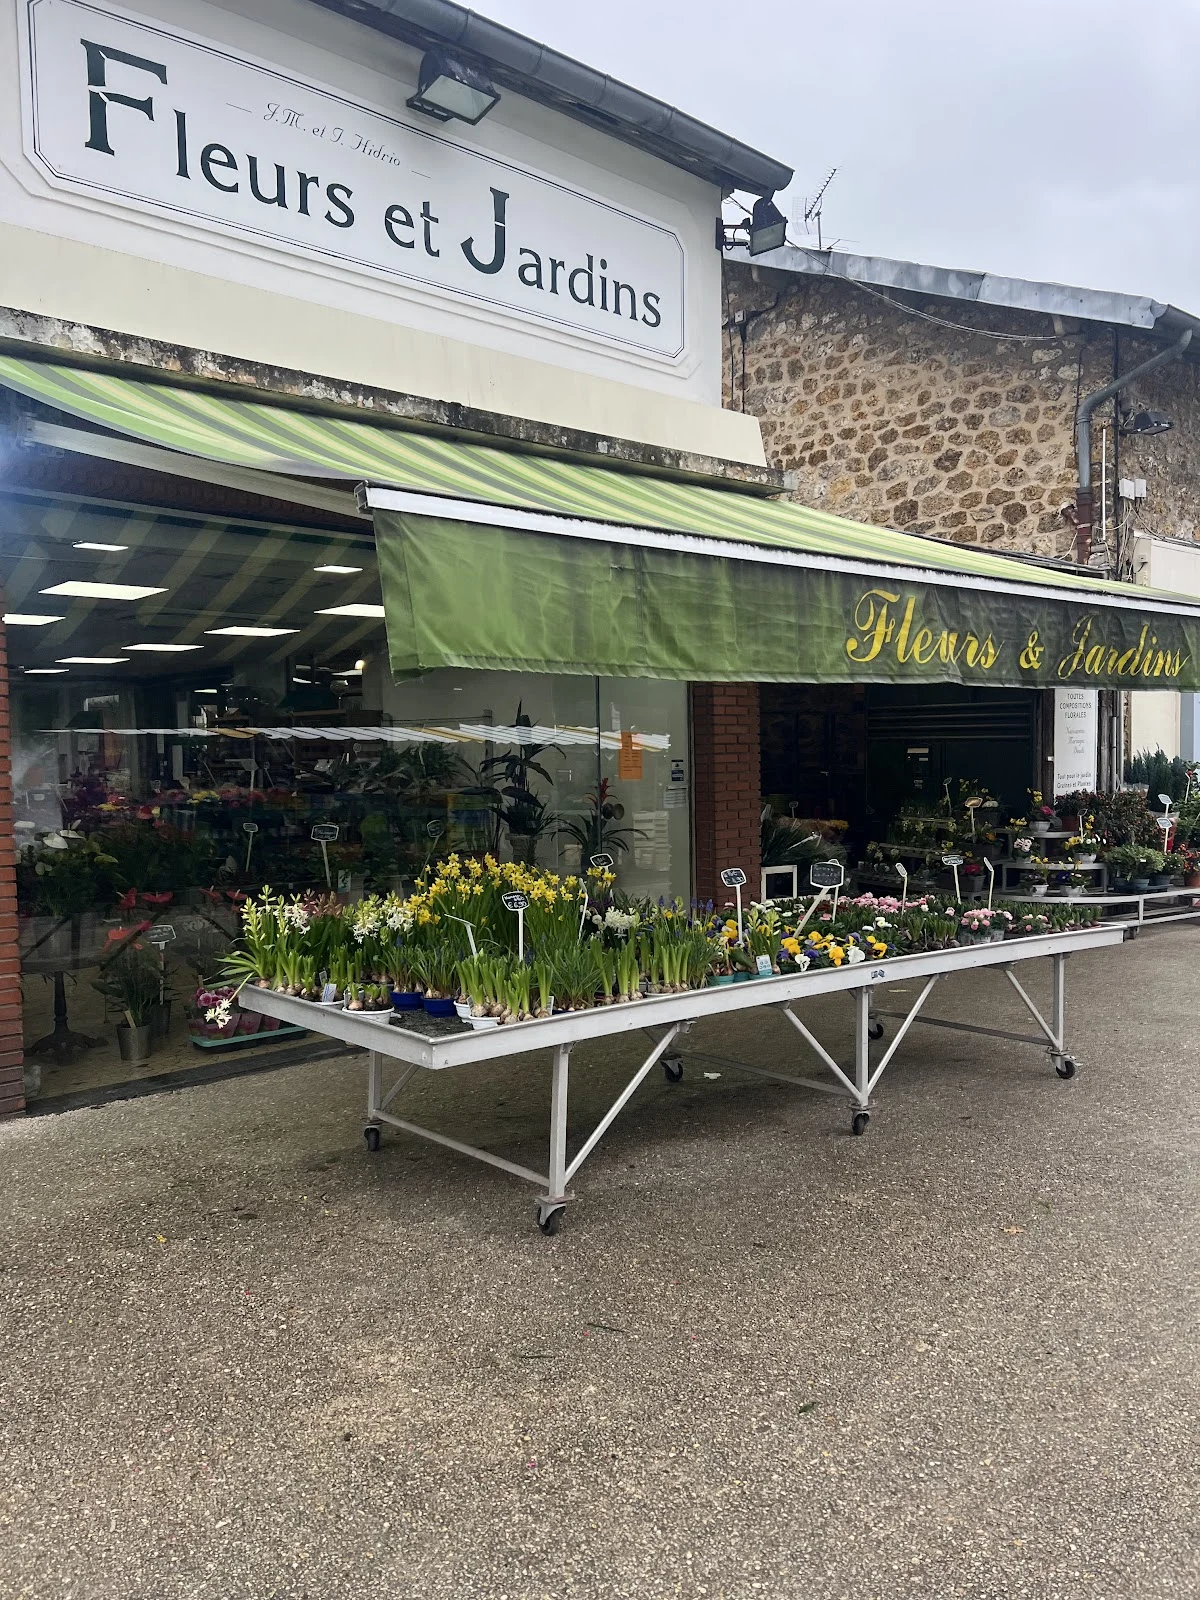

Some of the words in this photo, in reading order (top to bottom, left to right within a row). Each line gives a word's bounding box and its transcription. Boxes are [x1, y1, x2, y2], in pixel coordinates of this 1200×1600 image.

[312, 125, 327, 139] et
[350, 133, 401, 166] Hidrio
[80, 38, 356, 229] Fleurs
[384, 200, 440, 257] et
[460, 186, 662, 329] Jardins
[845, 588, 1005, 670] Fleurs
[1019, 630, 1045, 670] &
[1057, 613, 1193, 680] Jardins
[1064, 711, 1087, 719] FLORALES
